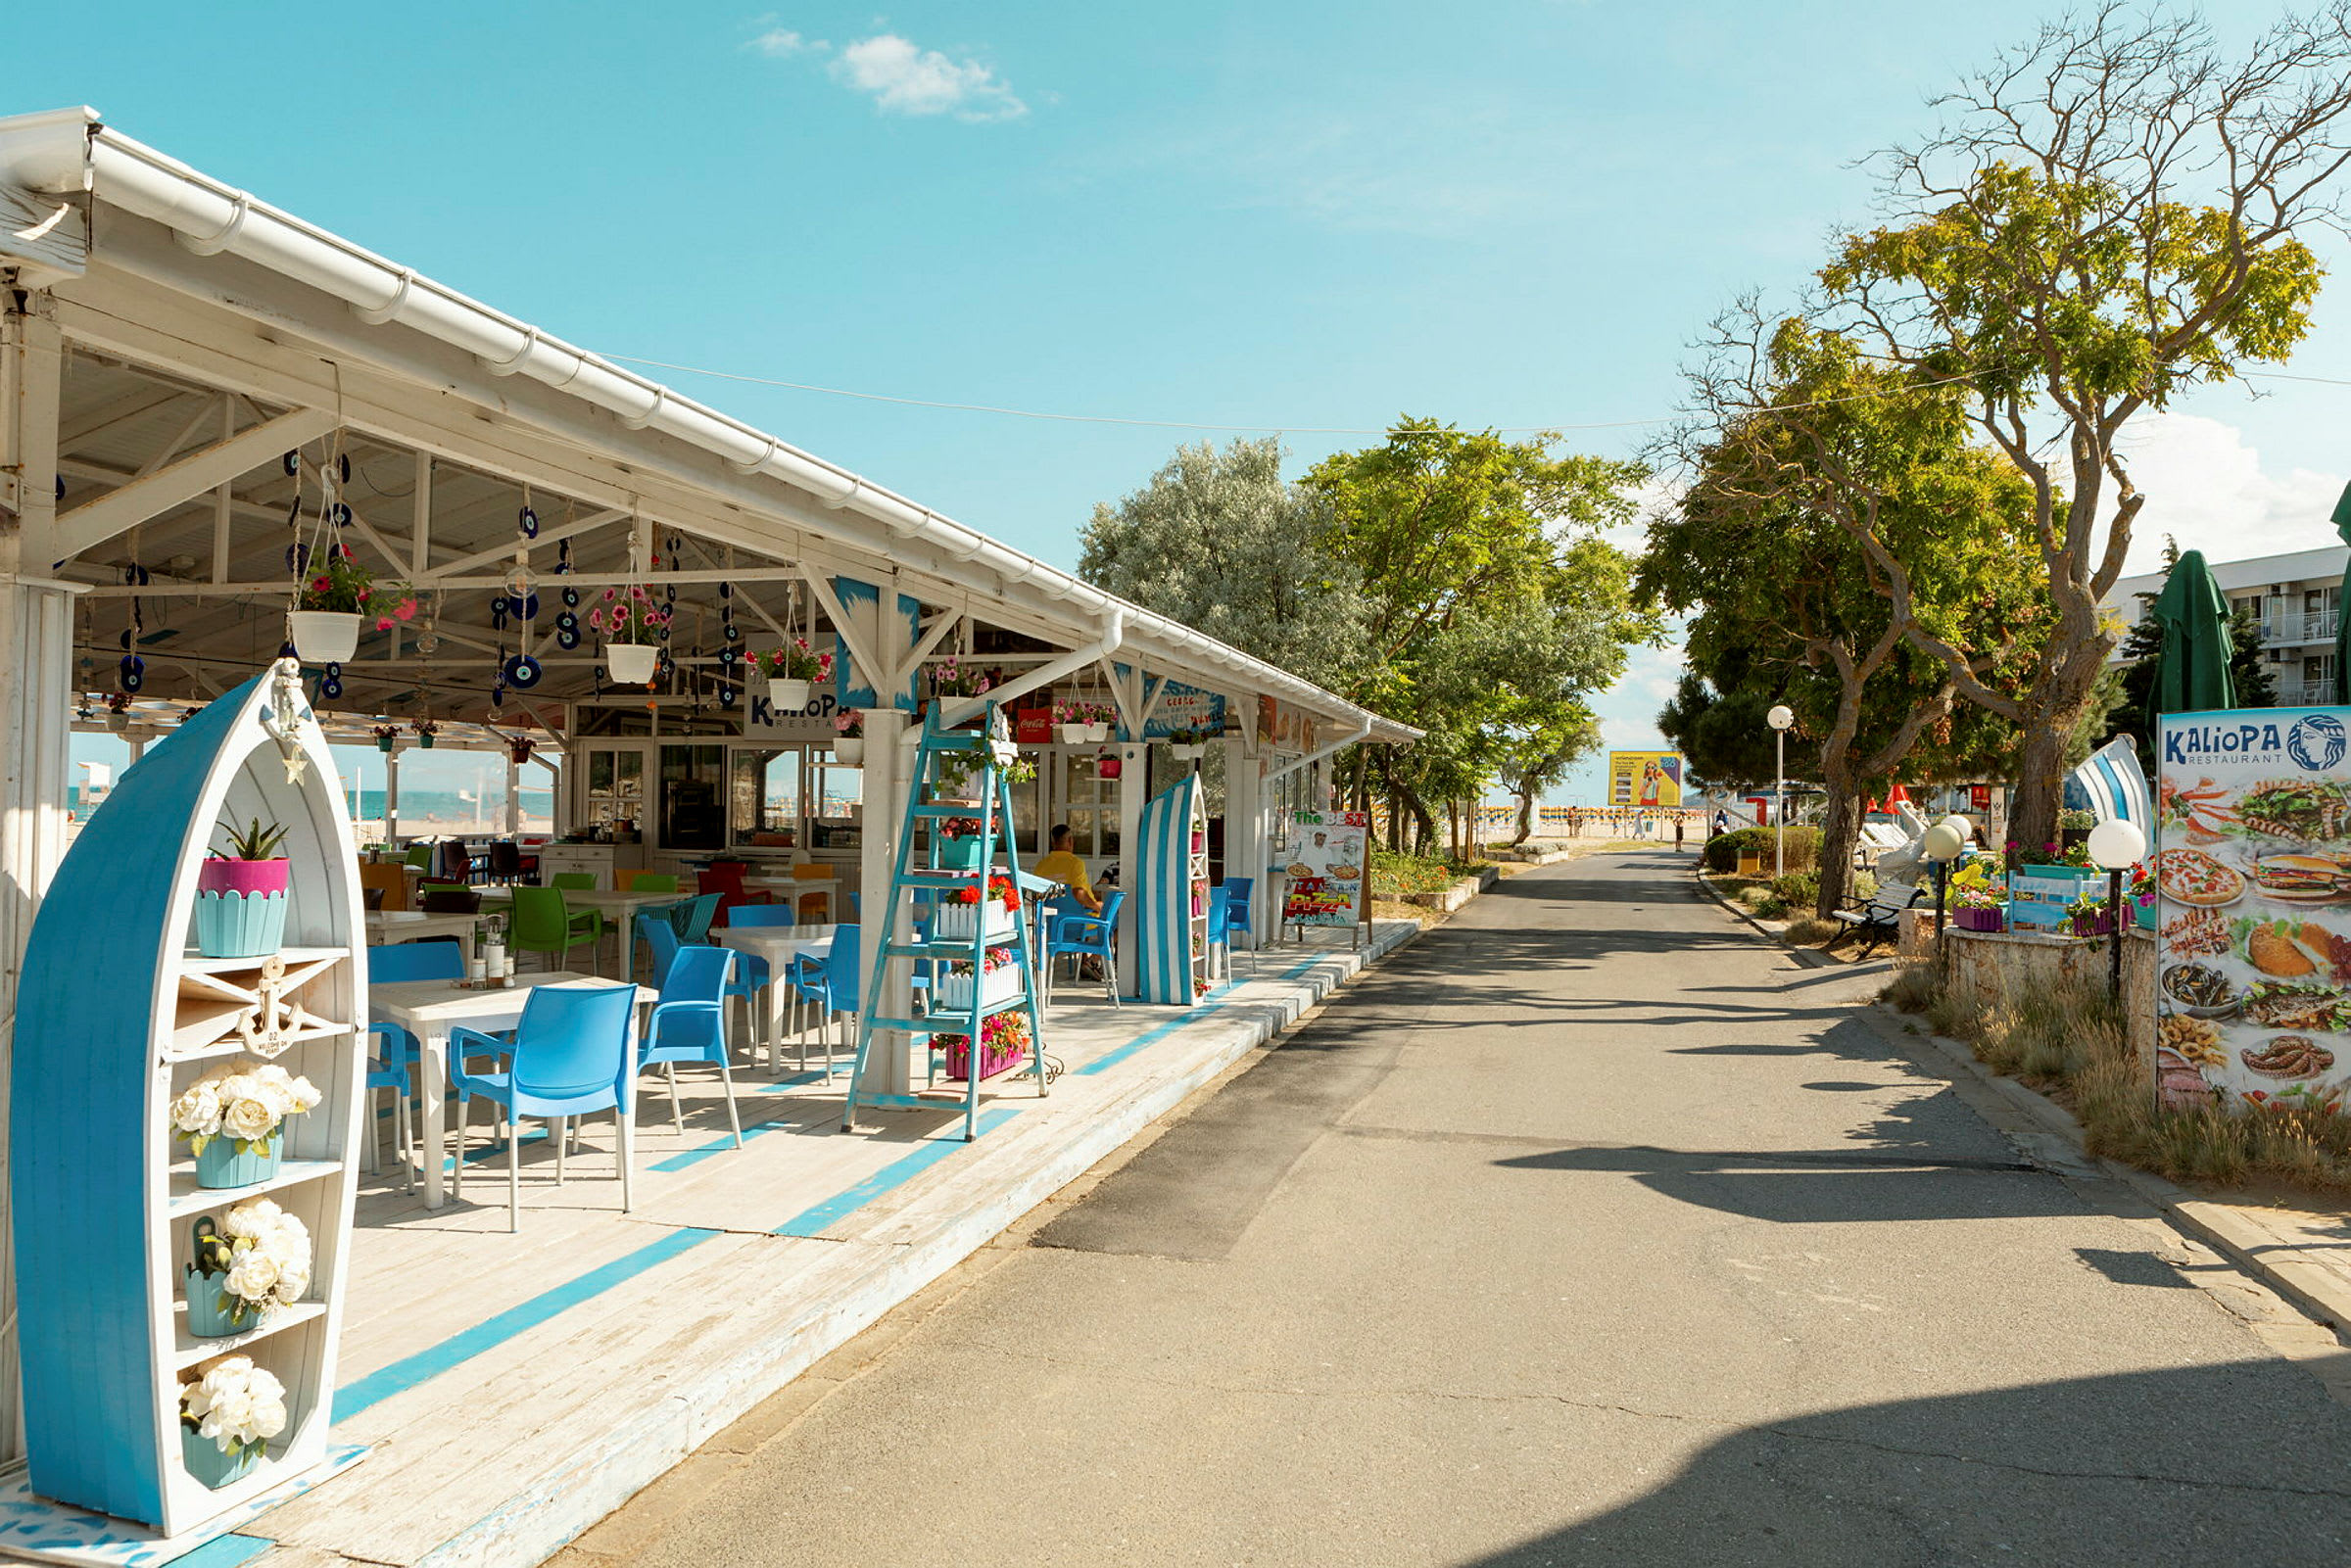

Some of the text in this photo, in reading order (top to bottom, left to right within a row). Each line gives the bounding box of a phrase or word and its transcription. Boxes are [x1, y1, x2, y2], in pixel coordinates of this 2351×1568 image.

[2188, 754, 2282, 764] RESTAURANT
[1294, 811, 1366, 827] The BEST
